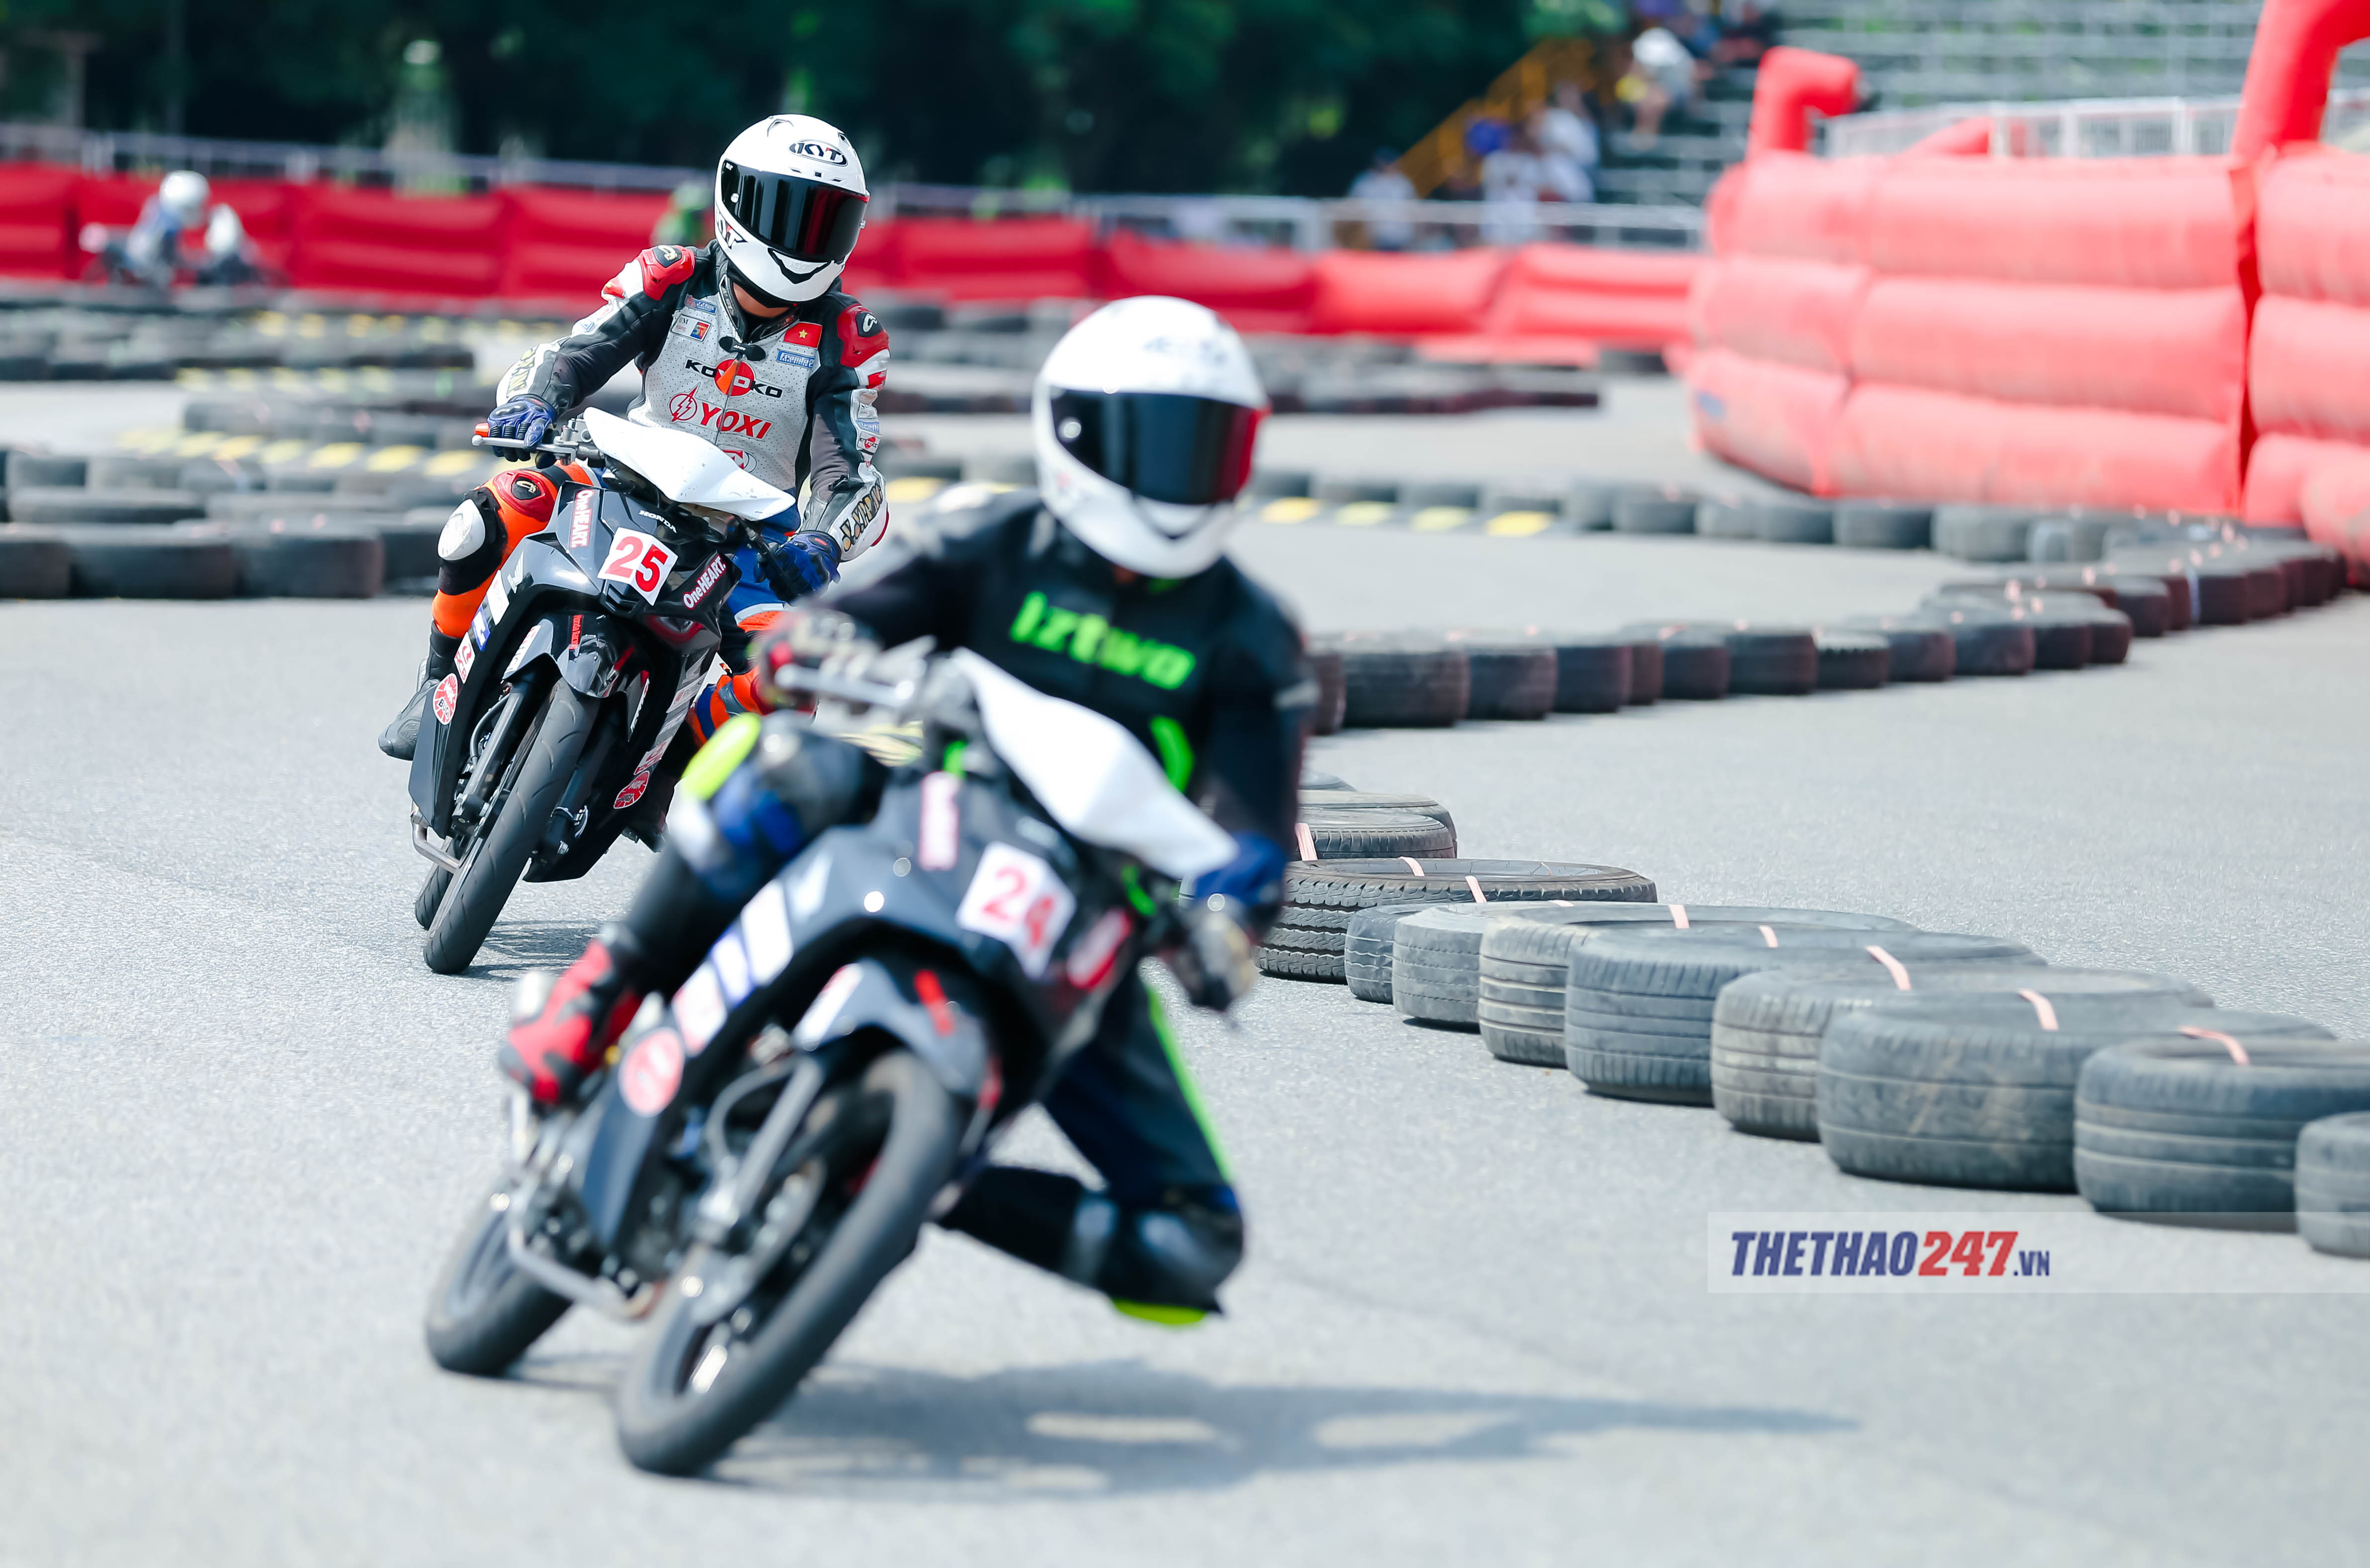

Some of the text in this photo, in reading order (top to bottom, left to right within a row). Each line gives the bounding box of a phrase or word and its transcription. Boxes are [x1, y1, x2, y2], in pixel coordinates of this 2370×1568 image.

[796, 142, 841, 161] KYT
[700, 402, 772, 439] YOXI
[638, 510, 677, 534] HONDA
[605, 536, 668, 592] 25
